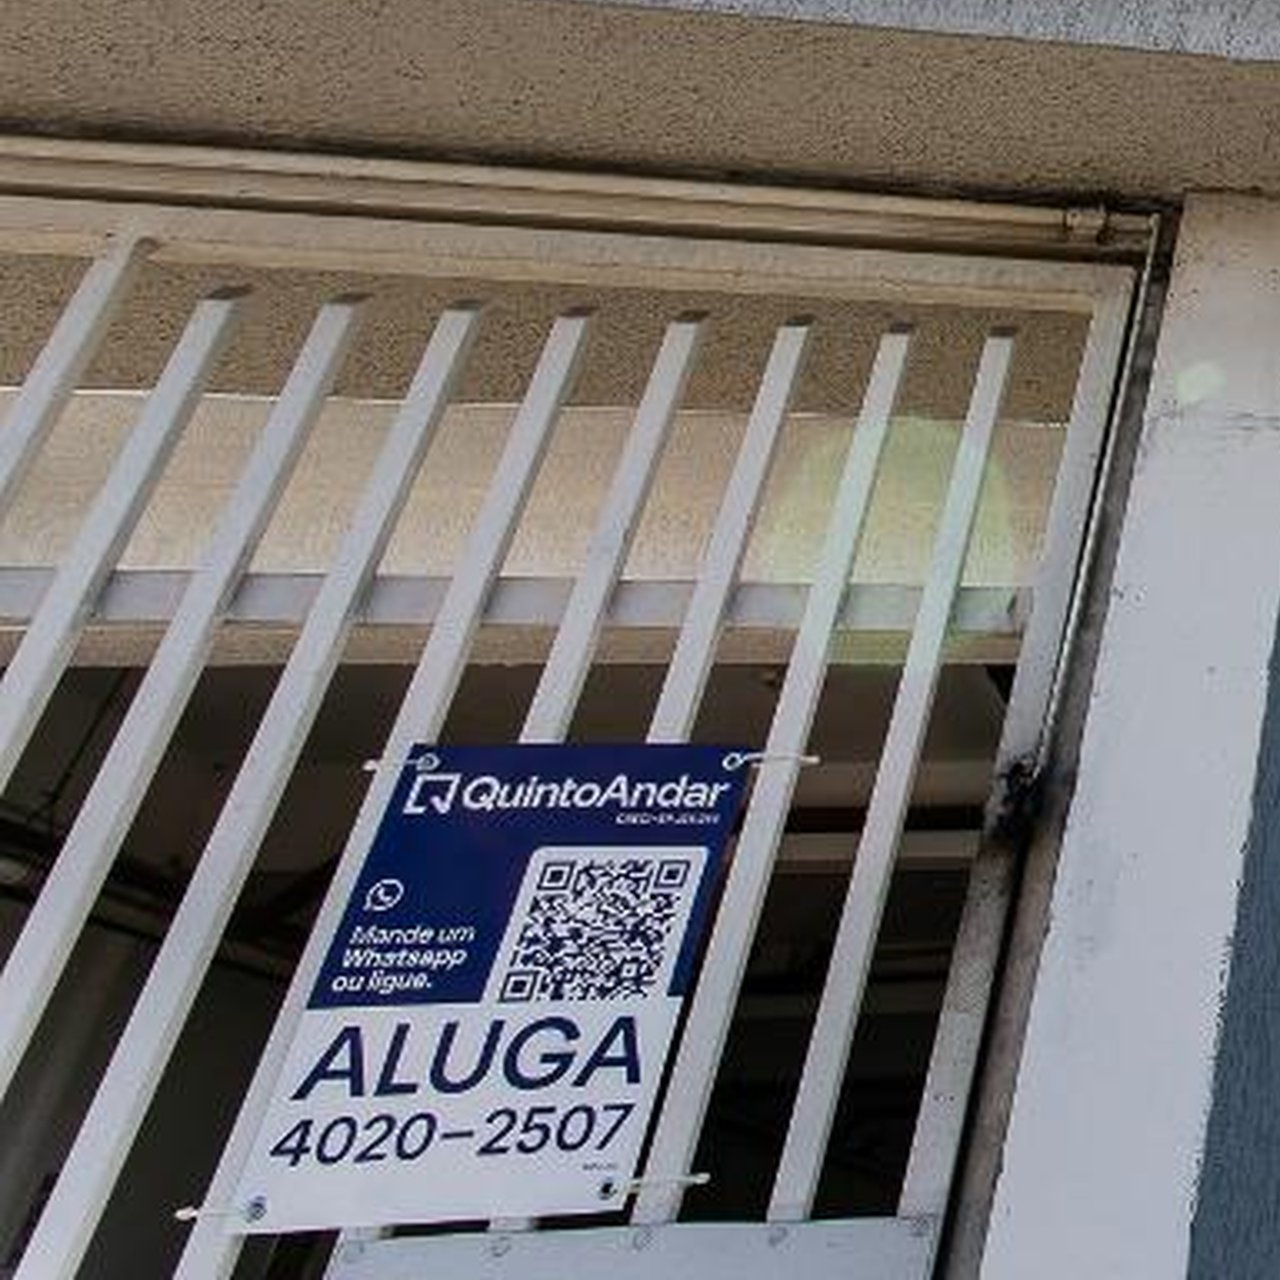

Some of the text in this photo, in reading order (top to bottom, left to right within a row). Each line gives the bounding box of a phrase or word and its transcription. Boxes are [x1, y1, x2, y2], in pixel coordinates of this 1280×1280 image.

[461, 774, 730, 812] QuintoAndar
[349, 925, 476, 945] Mande um
[342, 948, 468, 970] Whatsapp
[331, 970, 432, 995] ou ligue.
[290, 1017, 642, 1101] ALUGA
[269, 1103, 636, 1167] 4020-2507
